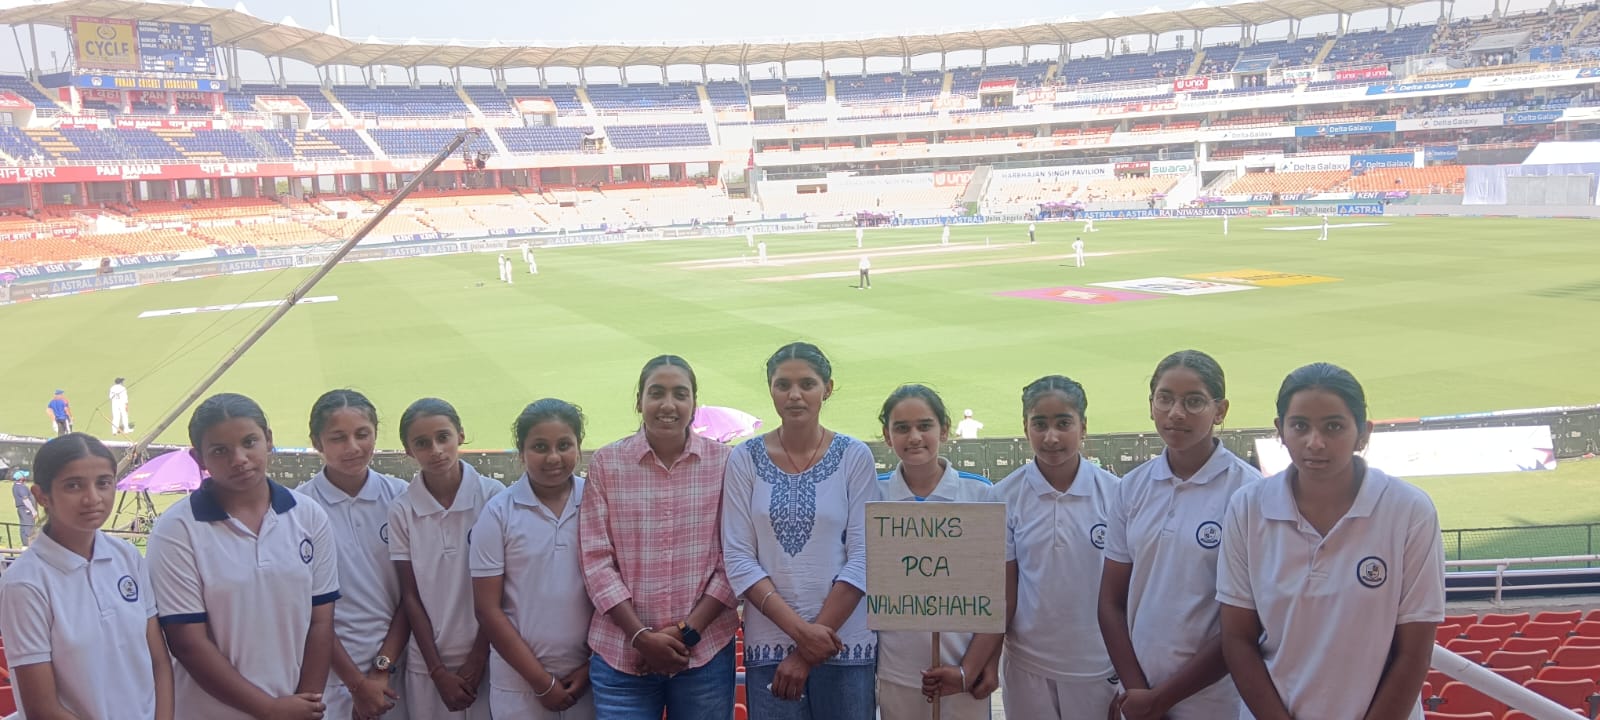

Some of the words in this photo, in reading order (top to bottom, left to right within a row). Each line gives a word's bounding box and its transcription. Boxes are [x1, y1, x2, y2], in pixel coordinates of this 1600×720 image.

[85, 40, 129, 56] CYCLE
[1184, 78, 1205, 89] unix
[1398, 81, 1422, 91] Delta
[1422, 79, 1457, 90] Galaxy
[1433, 118, 1452, 127] Delta
[1452, 116, 1479, 126] Galaxy
[1518, 113, 1537, 122] Delta
[1329, 124, 1349, 133] Delta
[1348, 122, 1374, 133] Galaxy
[1293, 162, 1316, 172] Delta
[1316, 161, 1349, 172] Galaxy
[1365, 160, 1386, 168] Delta
[1386, 158, 1414, 168] Galaxy
[97, 166, 120, 176] PAN
[121, 165, 162, 176] BAHAR
[1047, 169, 1070, 177] SINGH
[1072, 168, 1105, 176] PAVILION
[1279, 192, 1299, 201] KENT
[1356, 192, 1379, 200] KENT
[1084, 211, 1115, 220] ASTRAL
[1126, 209, 1158, 219] ASTRAL
[1159, 209, 1174, 218] RAJ
[1176, 208, 1203, 217] NIWAS
[1203, 208, 1219, 217] RAJ
[1221, 206, 1248, 216] NIWAS
[1348, 206, 1383, 214] ASTRAL
[913, 217, 943, 226] ASTRAL
[952, 215, 984, 225] ASTRAL
[226, 247, 246, 256] KENT
[120, 255, 140, 265] KENT
[146, 253, 166, 263] KENT
[18, 266, 40, 277] KENT
[45, 263, 67, 274] KENT
[229, 261, 261, 272] ASTRAL
[61, 279, 92, 291] ASTRAL
[103, 273, 135, 287] ASTRAL
[873, 516, 963, 538] THANKS
[901, 555, 950, 577] PCA
[866, 594, 993, 617] NAWANSHAHR
